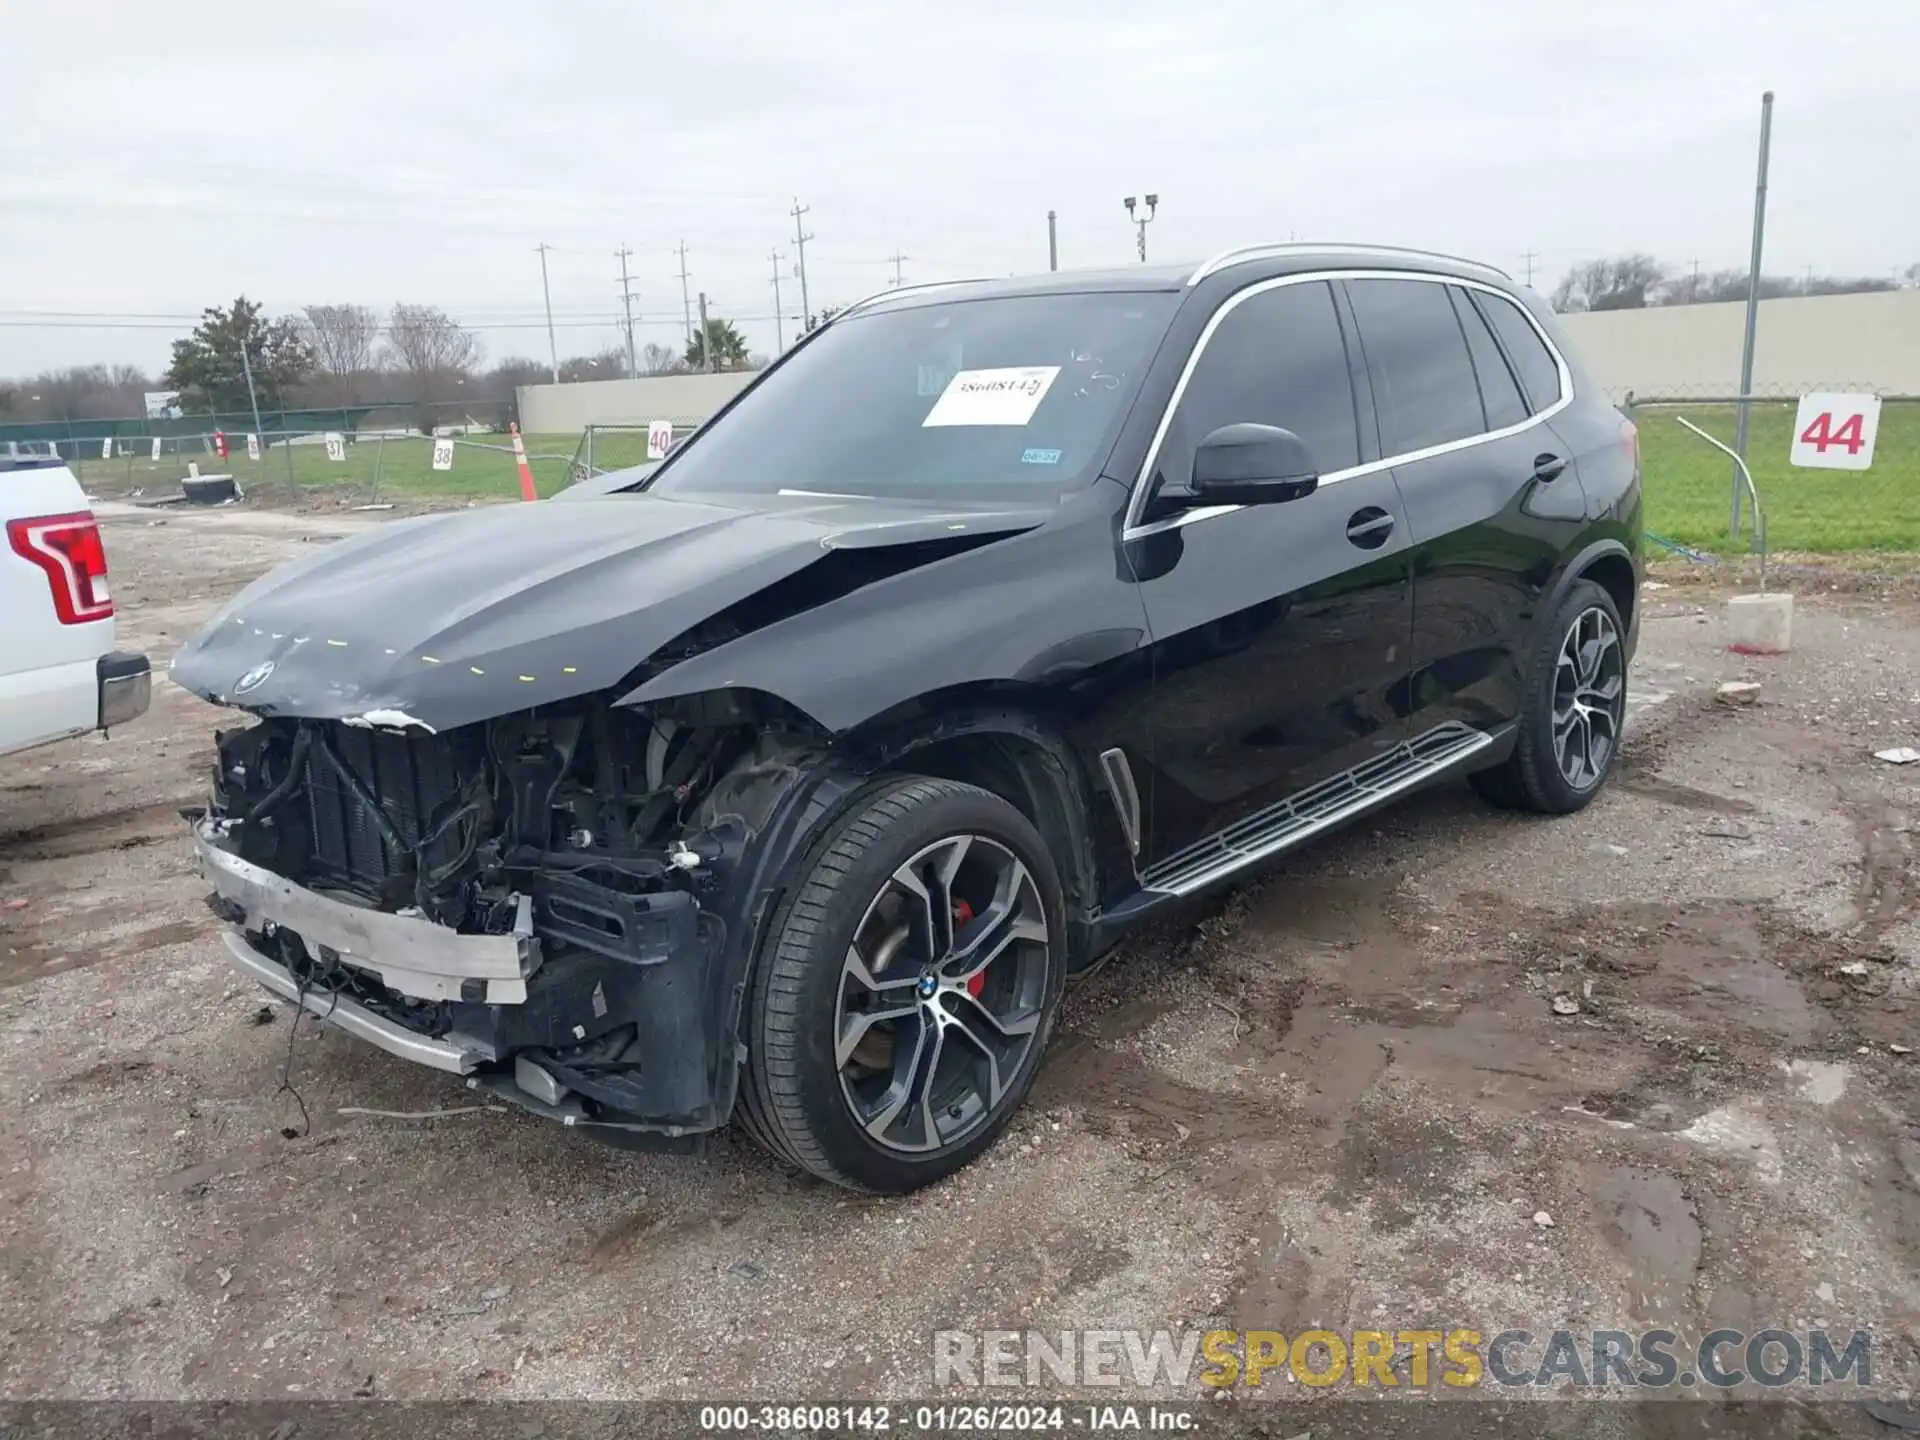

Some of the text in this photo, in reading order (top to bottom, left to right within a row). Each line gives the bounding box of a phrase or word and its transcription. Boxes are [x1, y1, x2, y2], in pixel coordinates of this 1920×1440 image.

[650, 430, 669, 451] 40
[1799, 411, 1867, 455] 44
[326, 439, 342, 457] 37
[434, 447, 452, 465] 38
